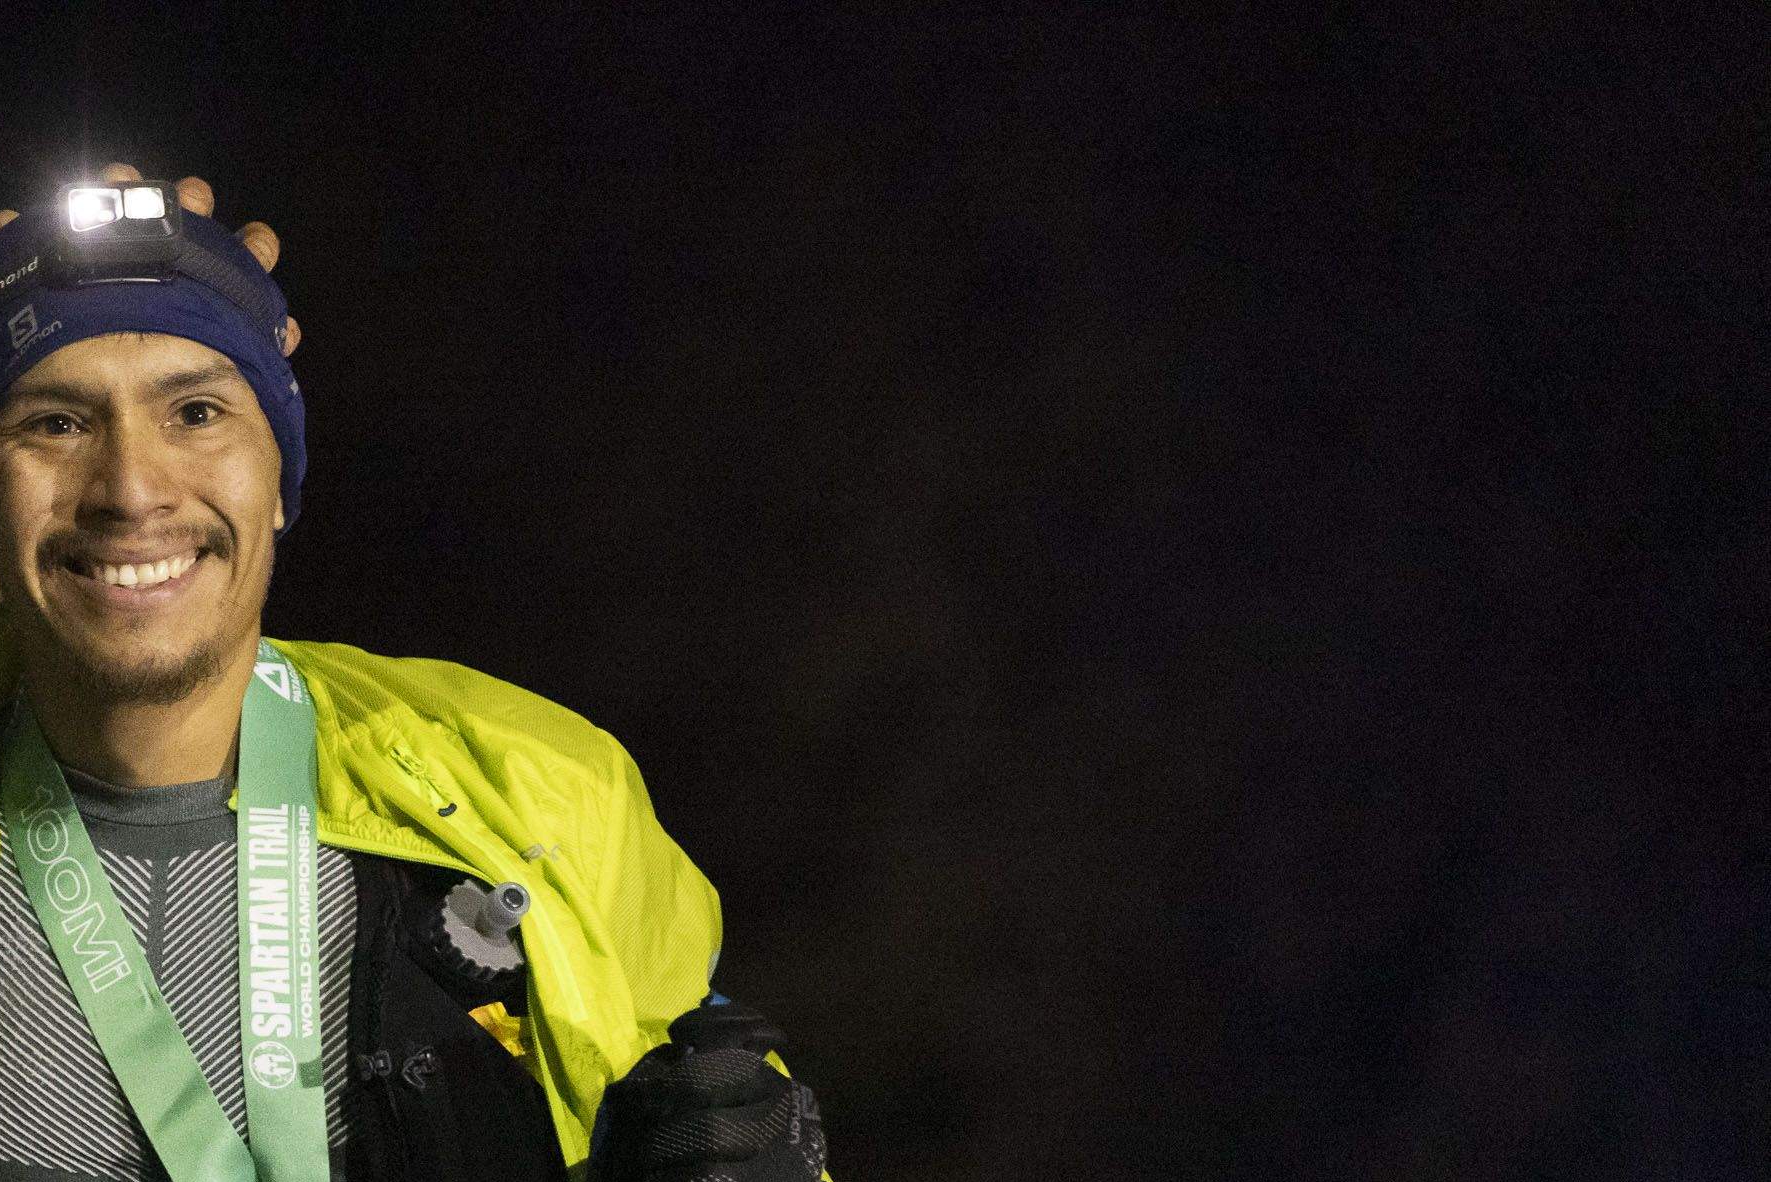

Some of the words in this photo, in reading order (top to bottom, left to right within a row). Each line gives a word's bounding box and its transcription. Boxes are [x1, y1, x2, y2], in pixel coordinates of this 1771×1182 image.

[248, 803, 289, 870] TRAIL
[298, 805, 312, 957] CHAMPIONSHIP
[248, 878, 293, 1038] SPARTAN
[299, 961, 314, 1039] WORLD
